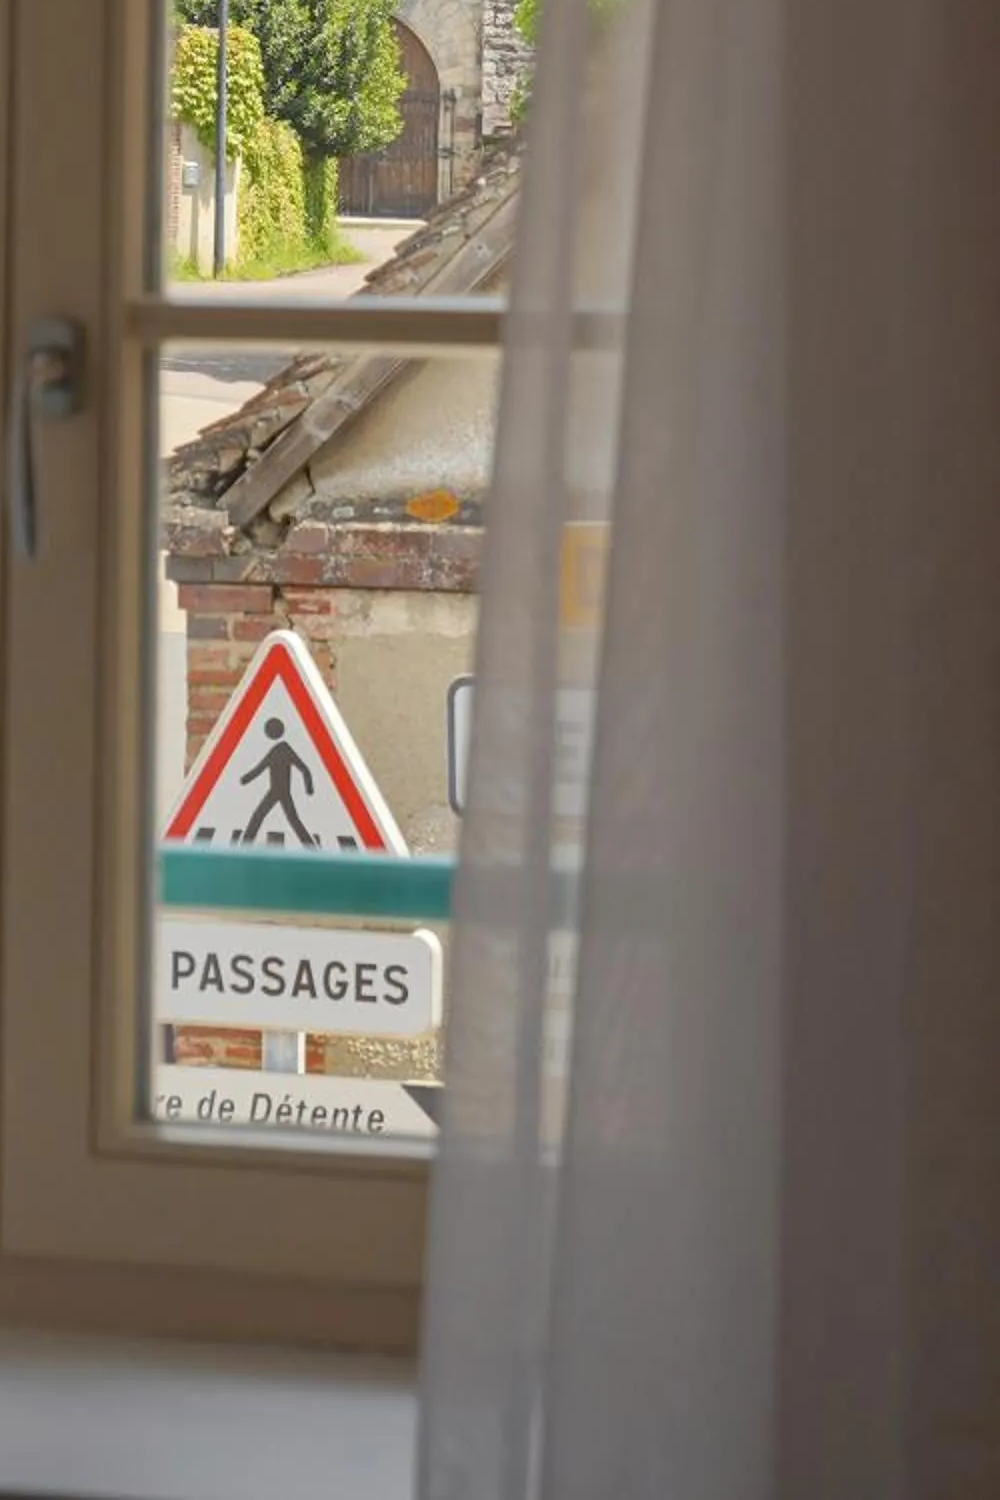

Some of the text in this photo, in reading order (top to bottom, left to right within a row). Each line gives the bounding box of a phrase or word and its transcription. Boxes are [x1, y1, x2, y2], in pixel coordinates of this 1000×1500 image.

[171, 951, 410, 1005] PASSAGES
[198, 1089, 235, 1122] de
[249, 1092, 386, 1133] Détente
